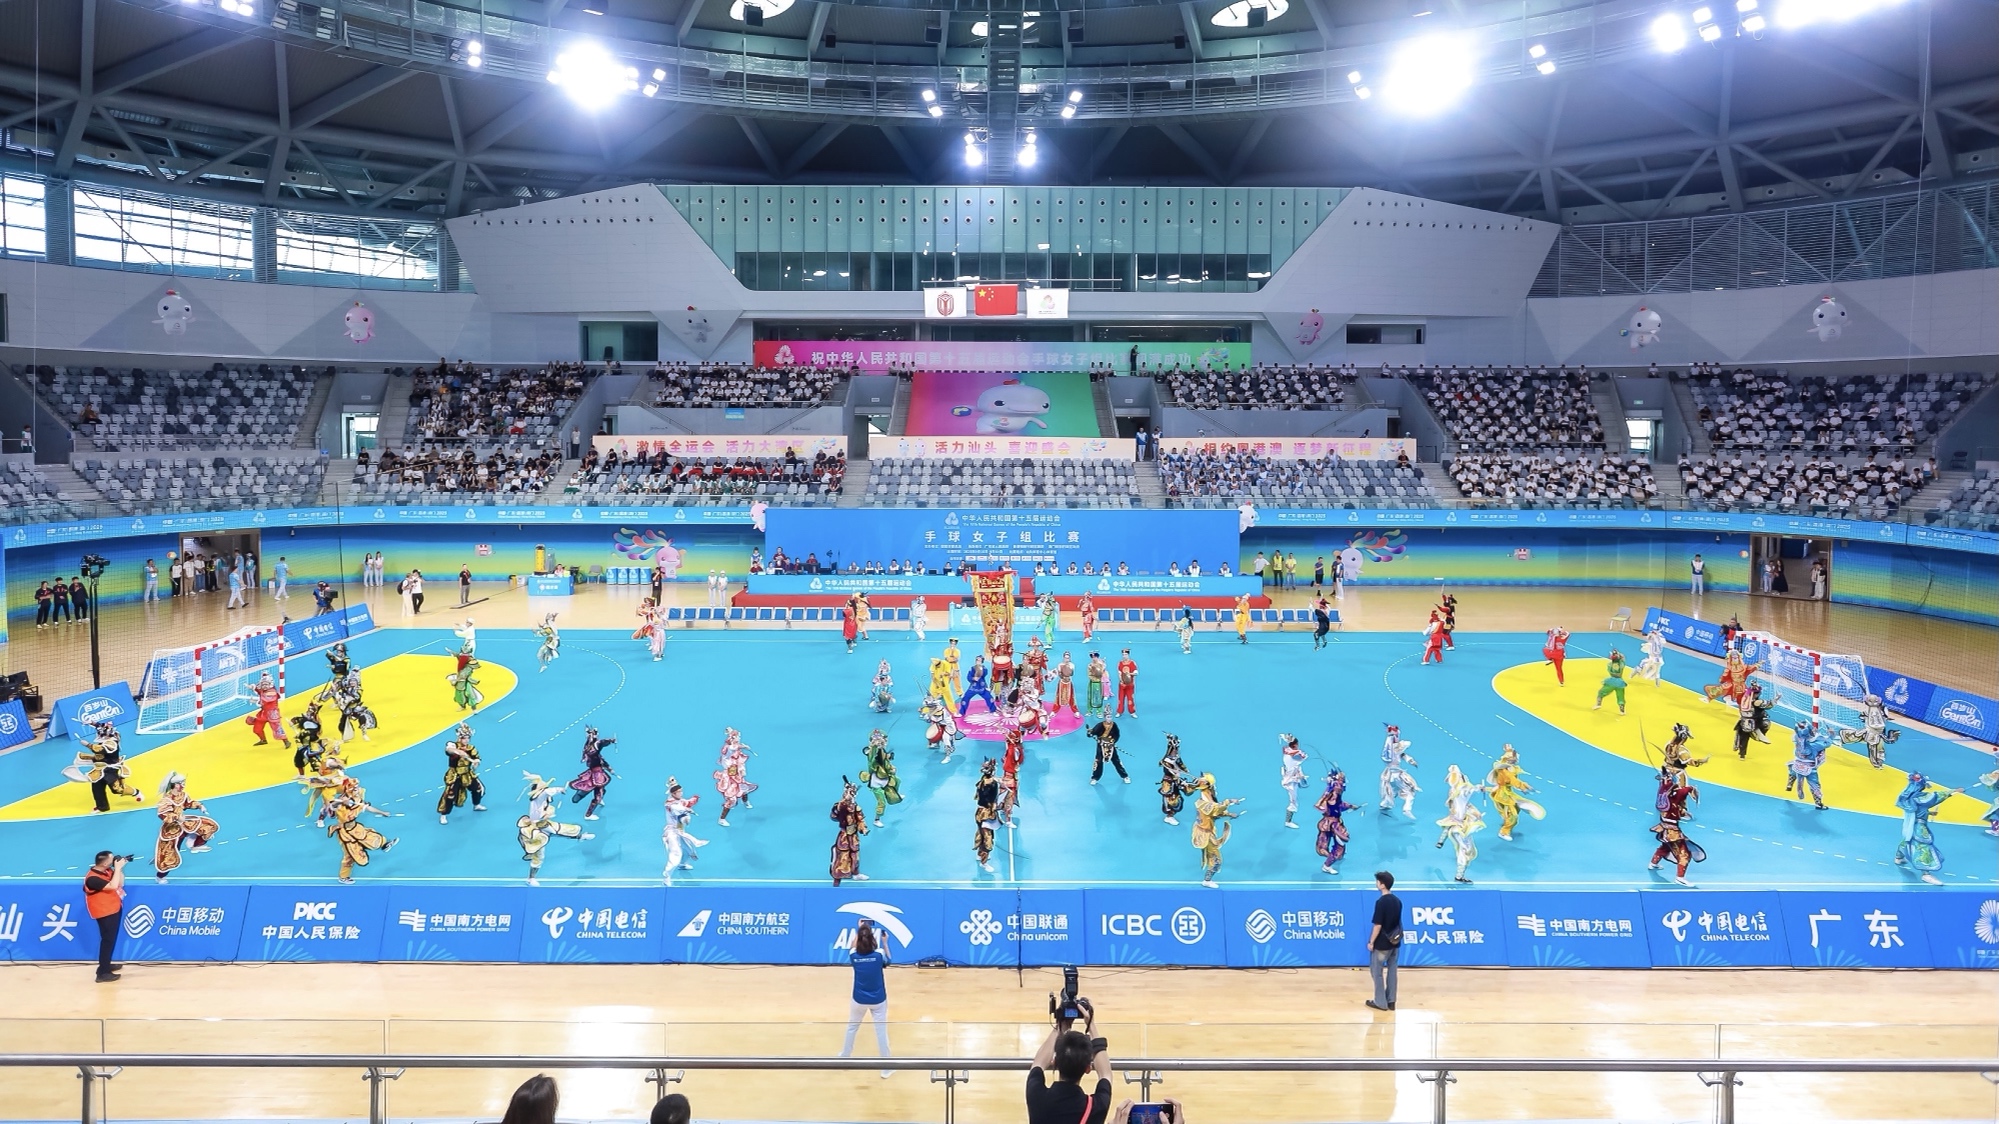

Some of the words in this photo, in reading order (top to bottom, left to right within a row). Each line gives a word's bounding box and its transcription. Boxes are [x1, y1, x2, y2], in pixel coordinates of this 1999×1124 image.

[636, 440, 715, 453] 激情全运会
[935, 441, 997, 454] 活力汕头
[1008, 441, 1070, 455] 喜迎盛会
[1293, 442, 1372, 456] 逐梦新征程
[924, 531, 1080, 542] 手球女子组比赛
[84, 700, 109, 712] 百岁山
[1951, 702, 1976, 715] 百岁山
[162, 907, 224, 924] 中国移动
[293, 902, 337, 920] PICC
[1412, 907, 1454, 925] PICC
[430, 914, 512, 927] 中国南方电网
[577, 908, 648, 930] 中国电信
[718, 912, 789, 926] 中国南方航空
[1007, 914, 1068, 929] 中国联通
[1102, 914, 1162, 936] ICBC
[1282, 911, 1344, 927] 中国移动
[1550, 919, 1632, 932] 中国南方电网
[1698, 911, 1768, 934] 中国电信
[159, 925, 187, 936] China
[188, 924, 220, 936] Mobile
[262, 925, 361, 940] 中国人民保险
[717, 927, 742, 935] CHINA
[745, 927, 789, 935] SOUTHERN
[1283, 930, 1312, 939] China
[1313, 930, 1345, 940] Mobile
[1808, 908, 1905, 949] 广东
[1035, 932, 1068, 941] unicom
[1403, 931, 1484, 944] 国人民保险
